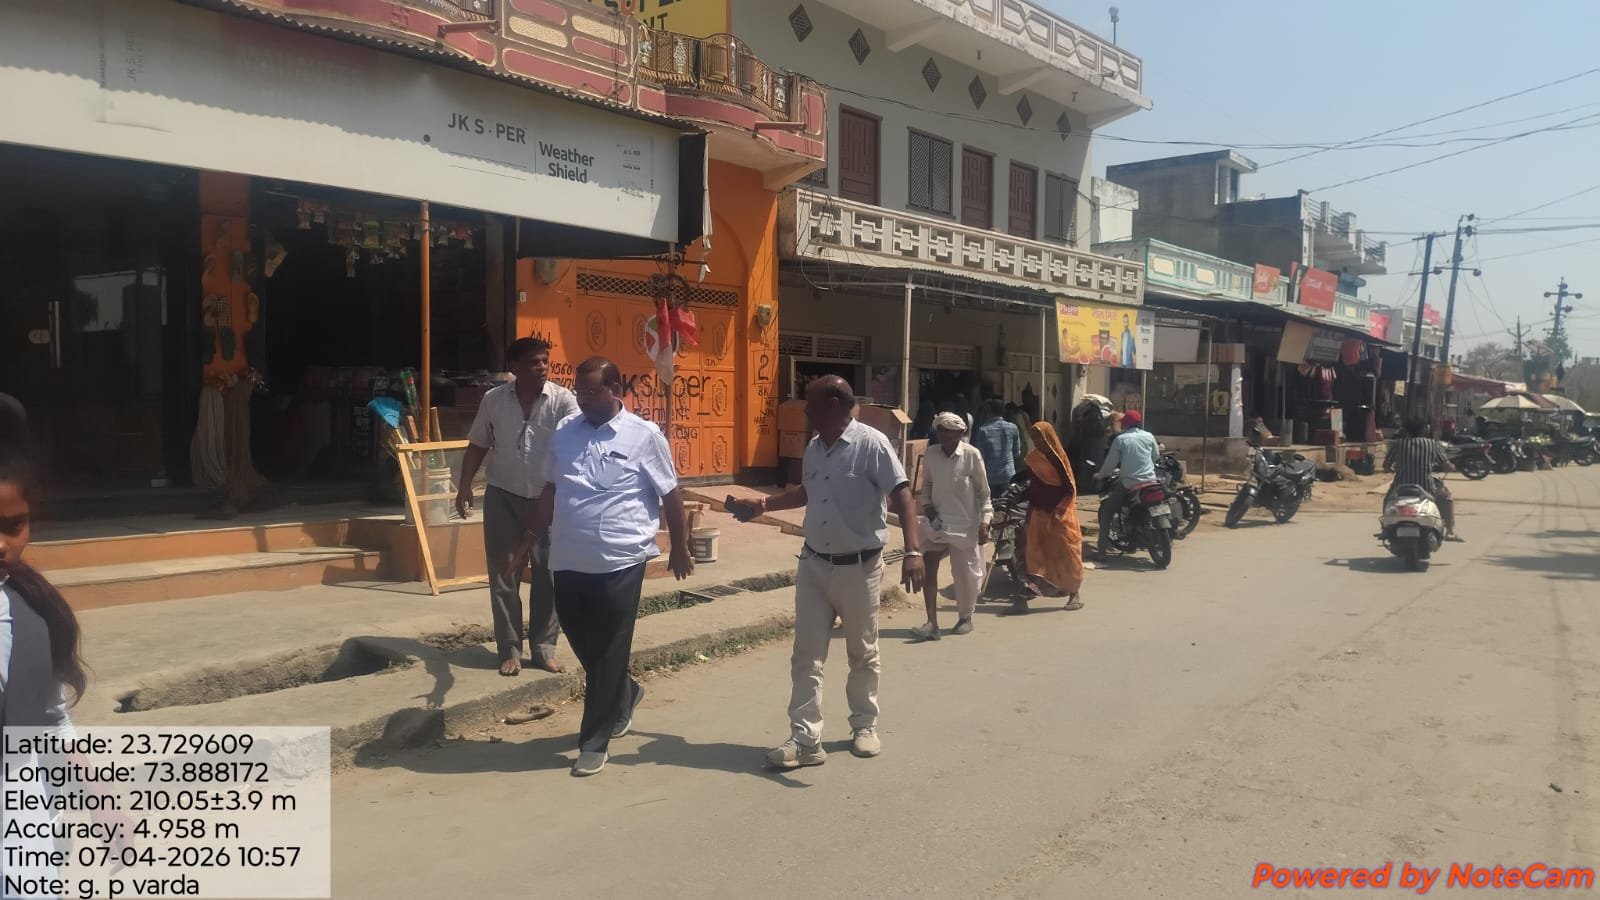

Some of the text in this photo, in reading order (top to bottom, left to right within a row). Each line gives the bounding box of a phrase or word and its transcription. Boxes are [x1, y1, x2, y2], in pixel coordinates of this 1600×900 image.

[538, 140, 595, 167] Weather
[548, 162, 588, 184] Shield
[758, 354, 769, 381] 2
[632, 406, 691, 421] cemnt
